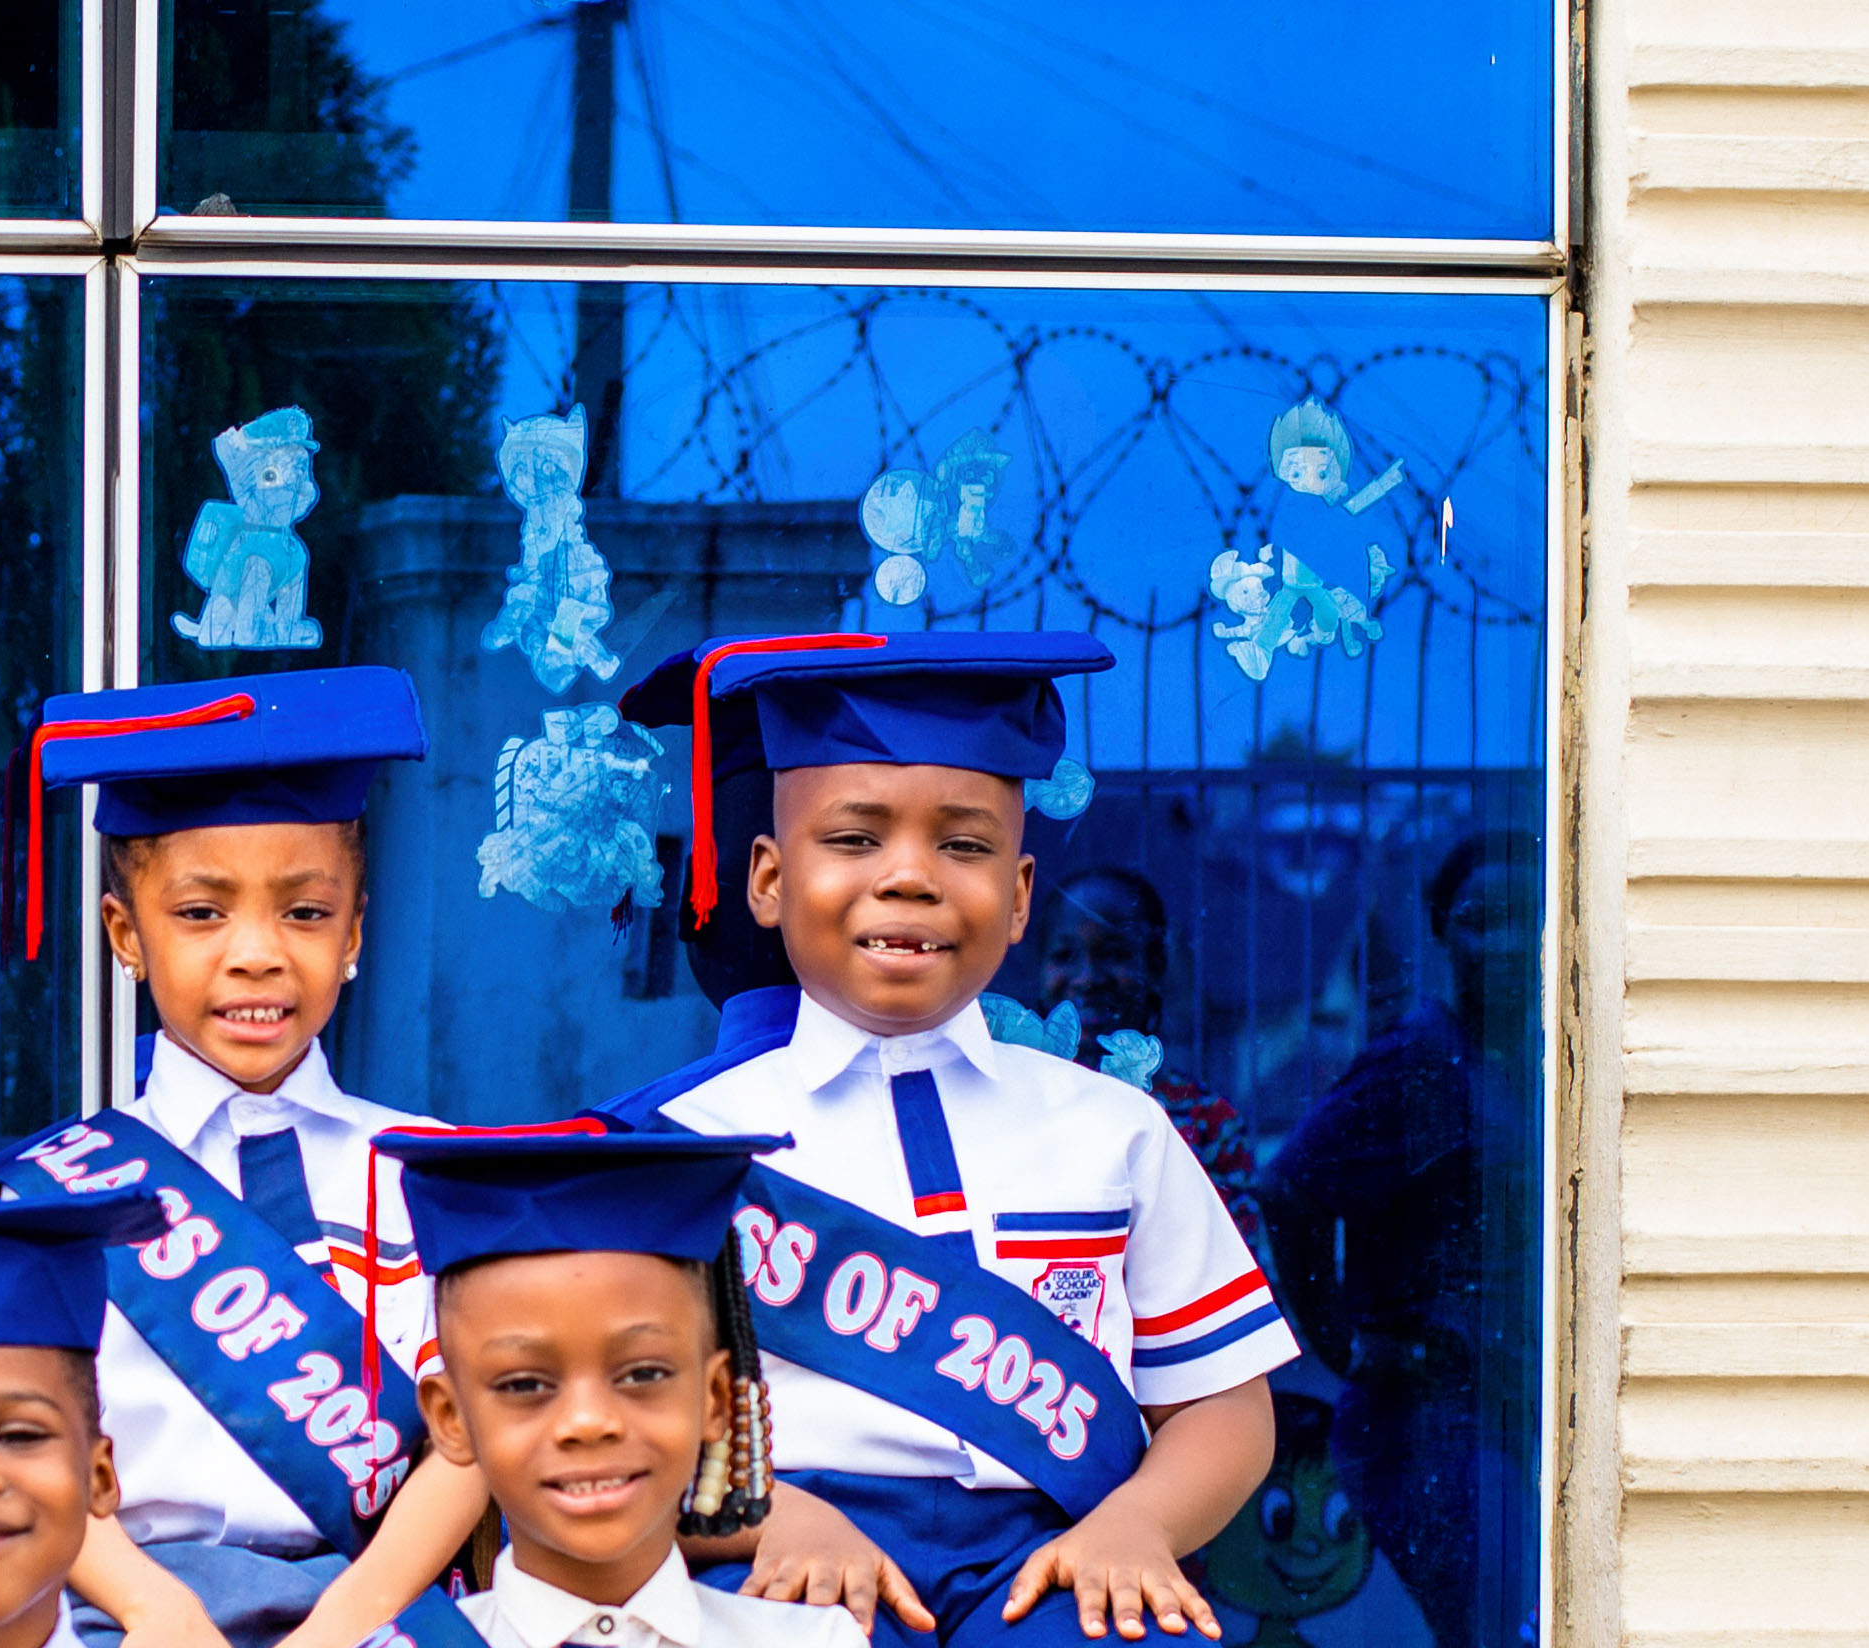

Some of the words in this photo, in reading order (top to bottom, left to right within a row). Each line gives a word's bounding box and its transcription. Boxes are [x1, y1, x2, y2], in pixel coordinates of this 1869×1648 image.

[191, 1266, 308, 1360] OF
[267, 1352, 410, 1520] 2025
[823, 1250, 939, 1353] OF
[934, 1314, 1098, 1461] 2025
